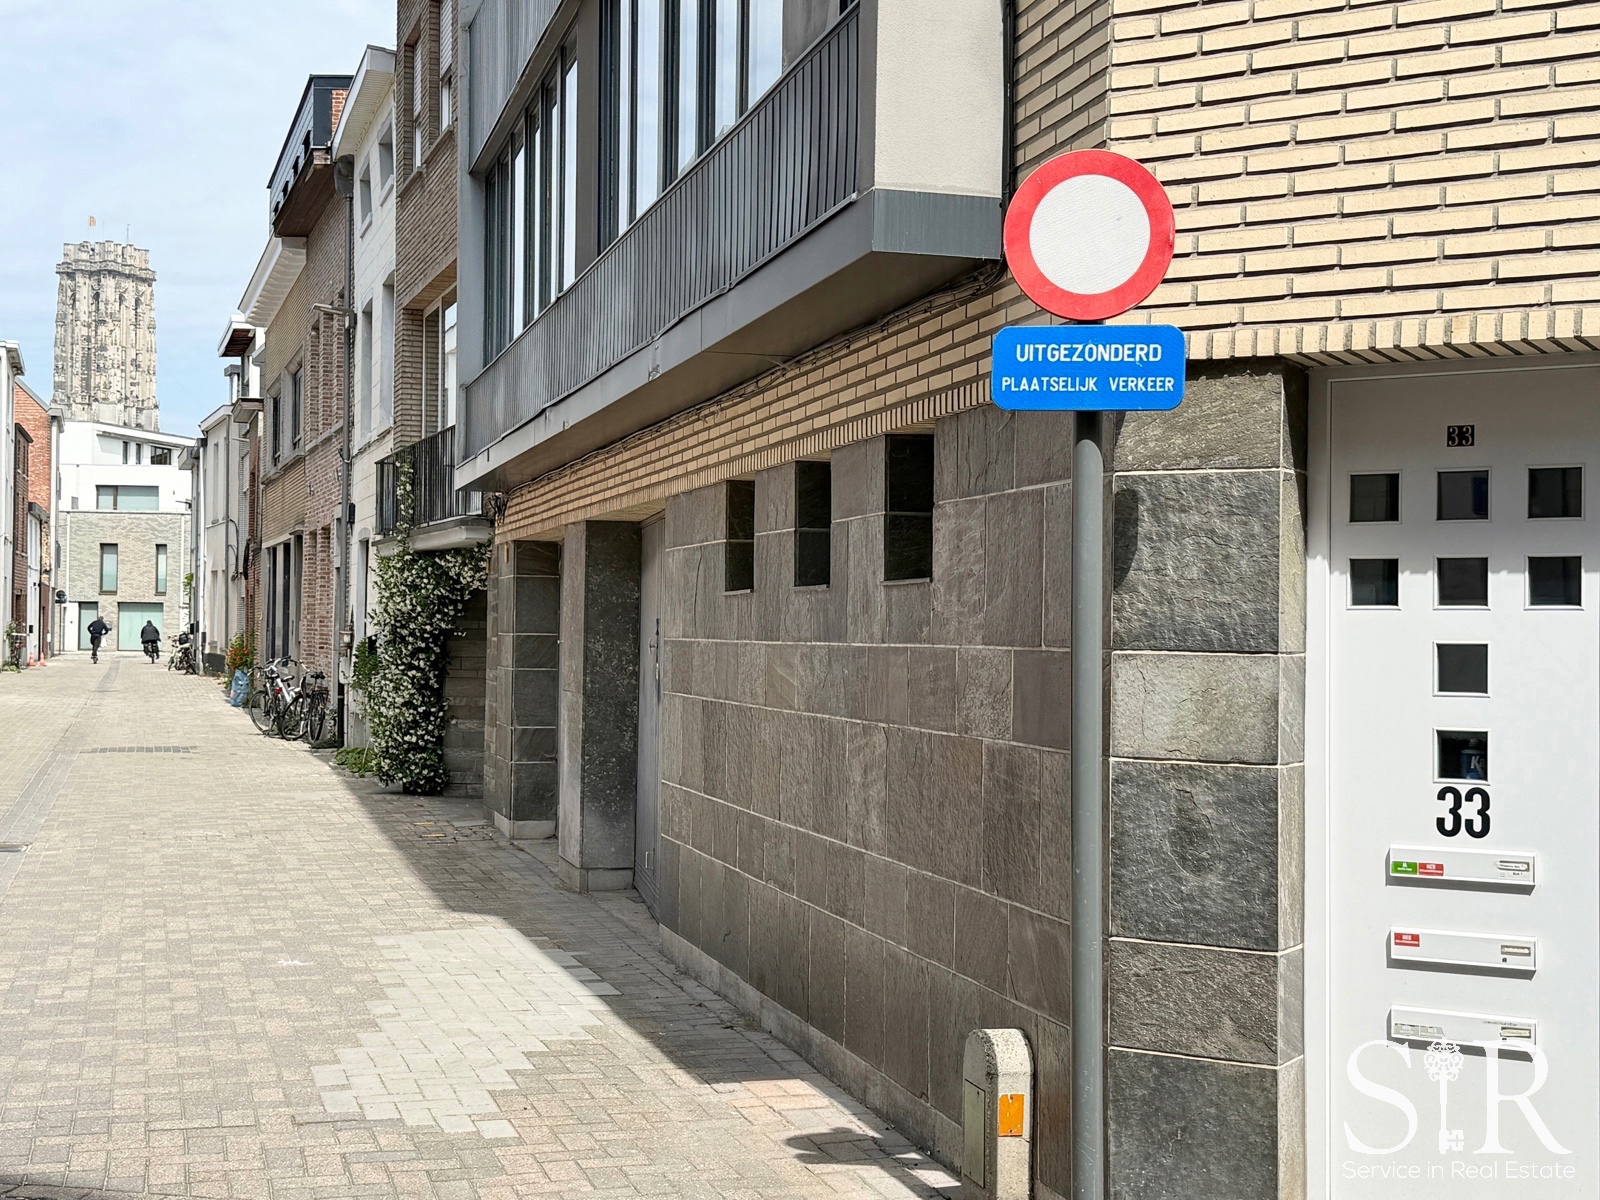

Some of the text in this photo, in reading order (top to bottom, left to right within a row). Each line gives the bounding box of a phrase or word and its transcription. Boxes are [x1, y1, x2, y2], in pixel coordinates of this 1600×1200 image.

[1015, 343, 1163, 362] UITGEZONDERD
[1001, 376, 1175, 392] PLAATSELIJK VERKEER
[1448, 426, 1473, 447] 33
[1436, 785, 1491, 839] 33
